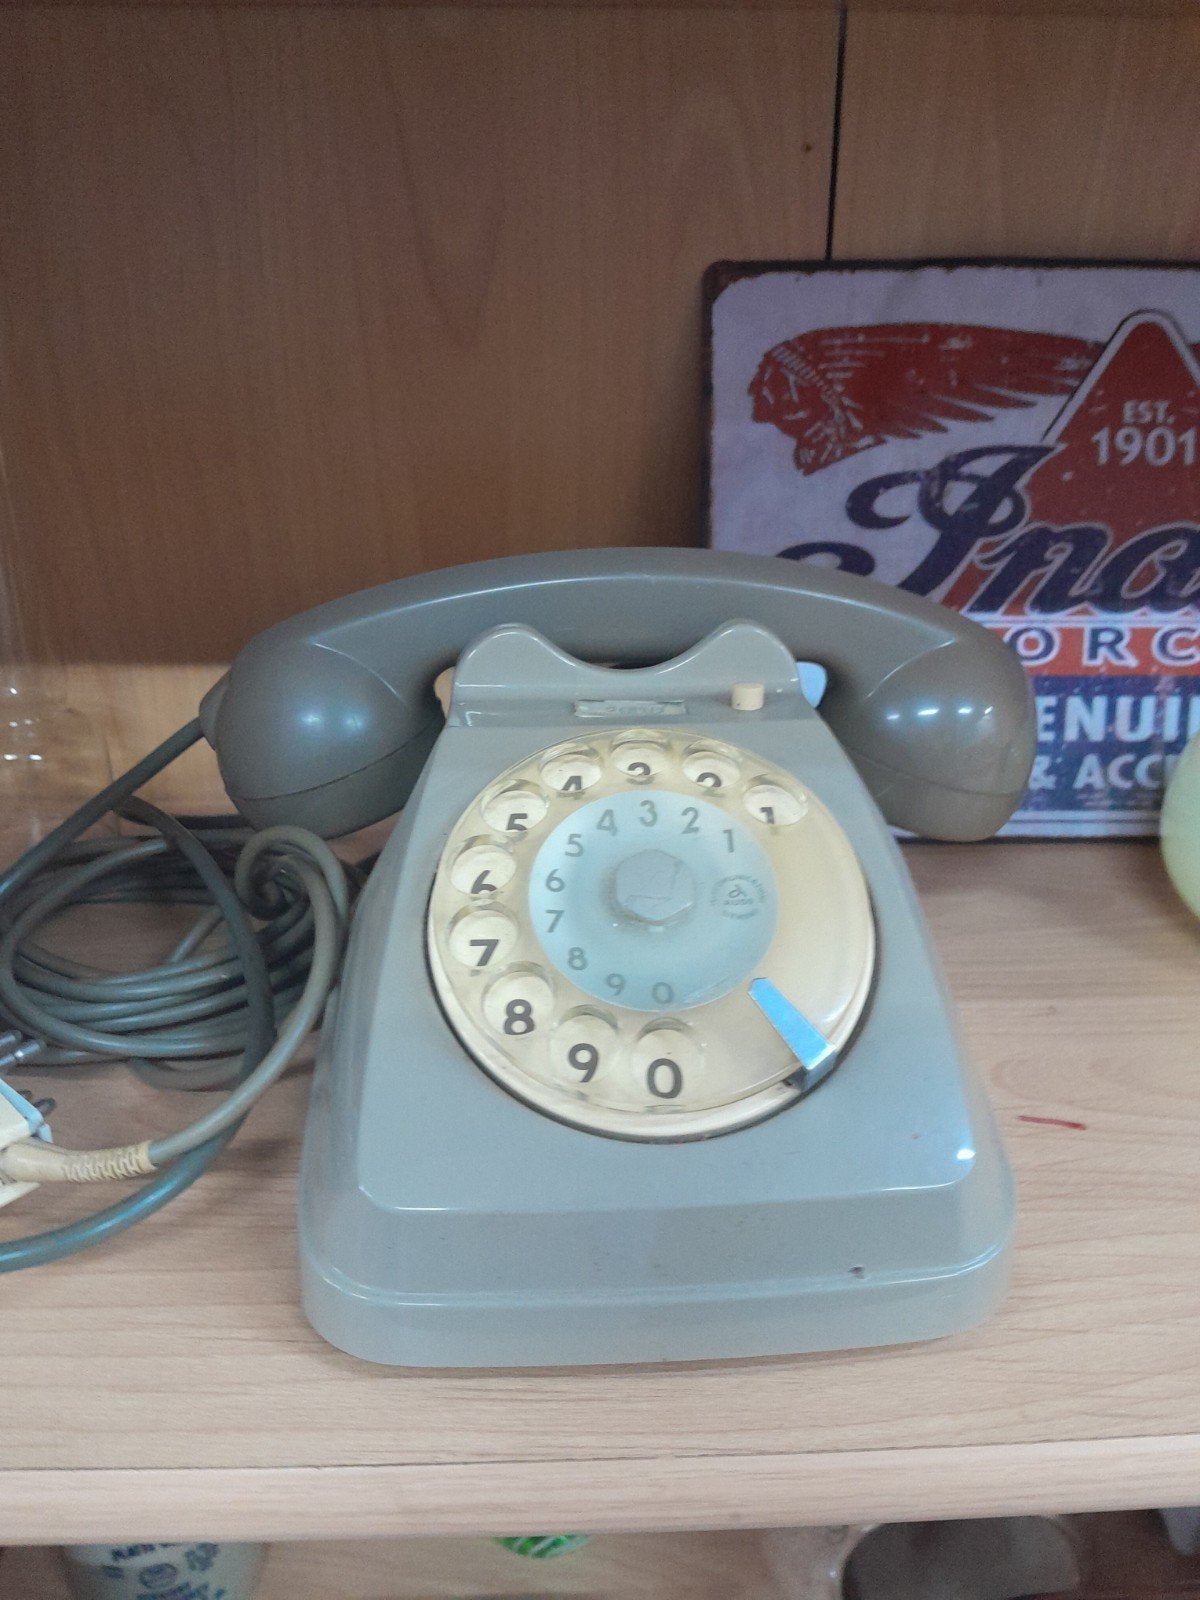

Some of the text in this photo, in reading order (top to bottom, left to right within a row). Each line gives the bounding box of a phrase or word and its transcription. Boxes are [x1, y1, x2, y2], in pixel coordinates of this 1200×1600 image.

[1122, 400, 1175, 424] EST.
[1091, 426, 1196, 468] 1901
[1073, 753, 1180, 789] ACC
[506, 812, 528, 834] 5
[597, 809, 617, 836] 4
[639, 799, 658, 827] 3
[681, 807, 699, 835] 2
[760, 806, 775, 828] 1
[564, 834, 584, 858] 5
[722, 829, 735, 853] 1
[545, 868, 566, 892] 6
[545, 909, 566, 934] 7
[470, 938, 499, 967] 7
[567, 946, 588, 971] 8
[606, 973, 625, 997] 9
[653, 982, 675, 1005] 0
[504, 998, 535, 1036] 8
[567, 1042, 599, 1083] 9
[646, 1057, 682, 1099] 0
